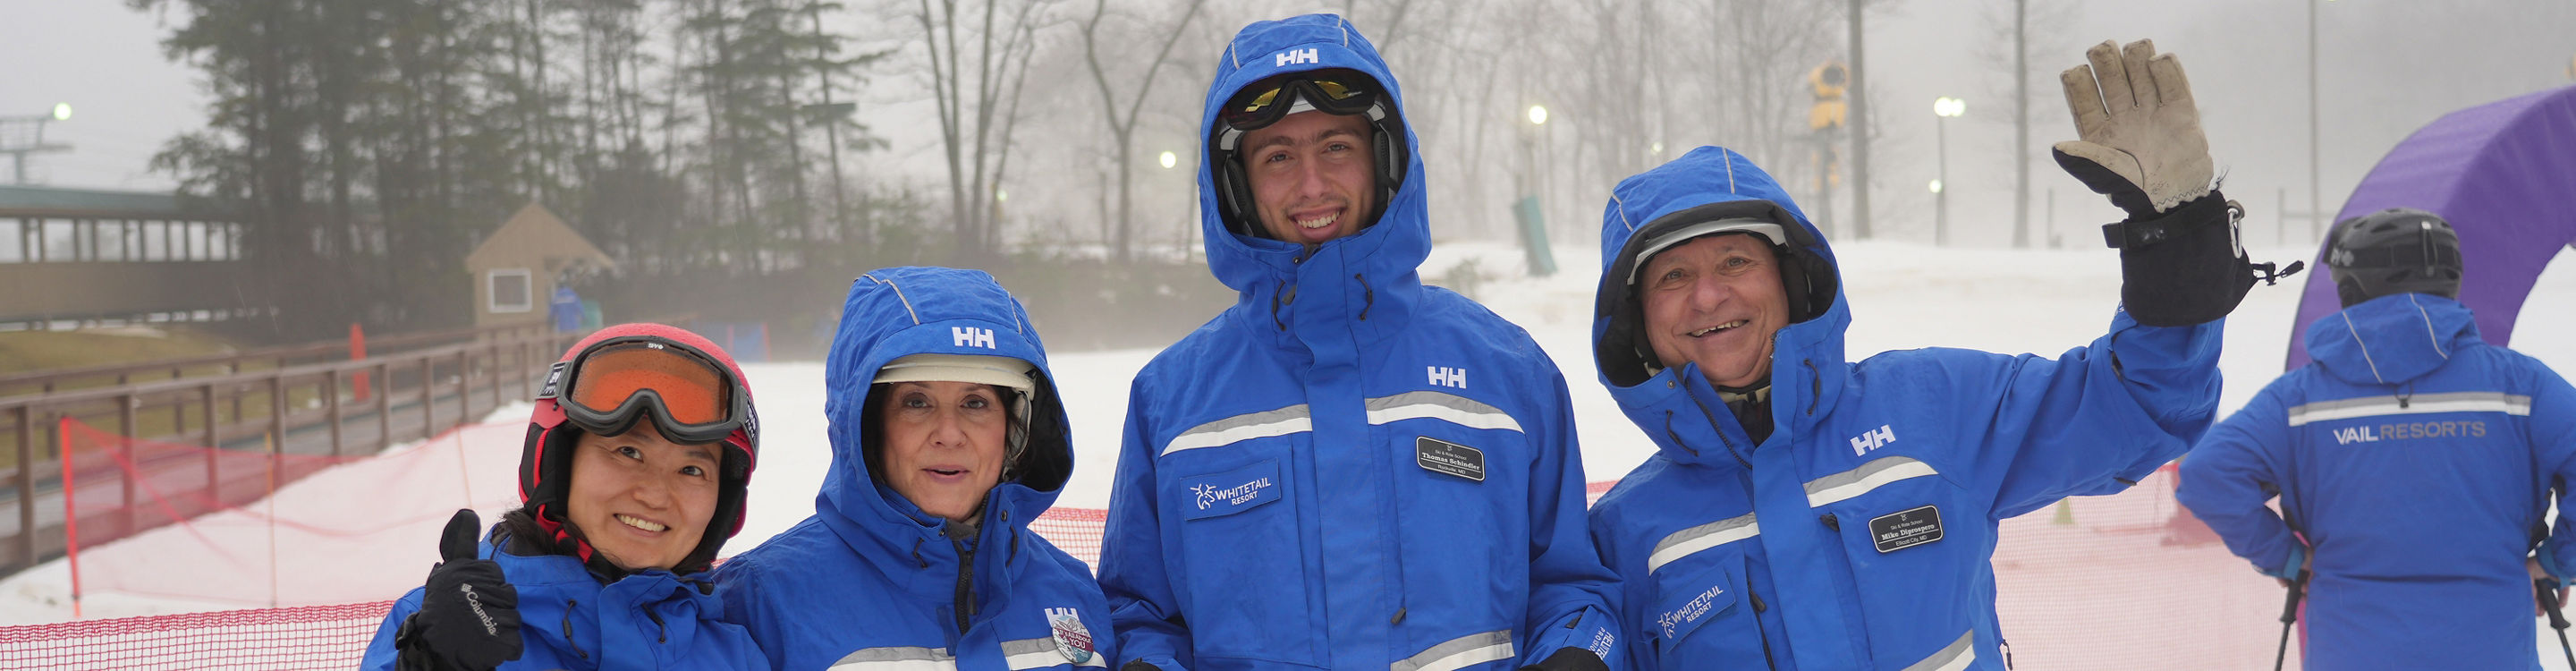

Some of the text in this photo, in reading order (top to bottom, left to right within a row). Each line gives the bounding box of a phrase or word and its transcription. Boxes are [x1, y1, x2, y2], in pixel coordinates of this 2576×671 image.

[1275, 48, 1318, 67] HH
[951, 327, 996, 350] HH
[1427, 366, 1467, 389] HH
[1850, 424, 1896, 457] HH
[2333, 421, 2487, 446] VAIL RESORTS
[1421, 452, 1480, 471] Thomas Schindler
[1215, 477, 1271, 500] WHITETAIL
[1232, 490, 1258, 505] RESORT
[1881, 524, 1935, 540] Mike Diprospero
[466, 591, 497, 635] Columbia
[1671, 585, 1724, 624] WHITETAIL
[1686, 601, 1712, 623] RESORT
[1069, 638, 1086, 649] YOU
